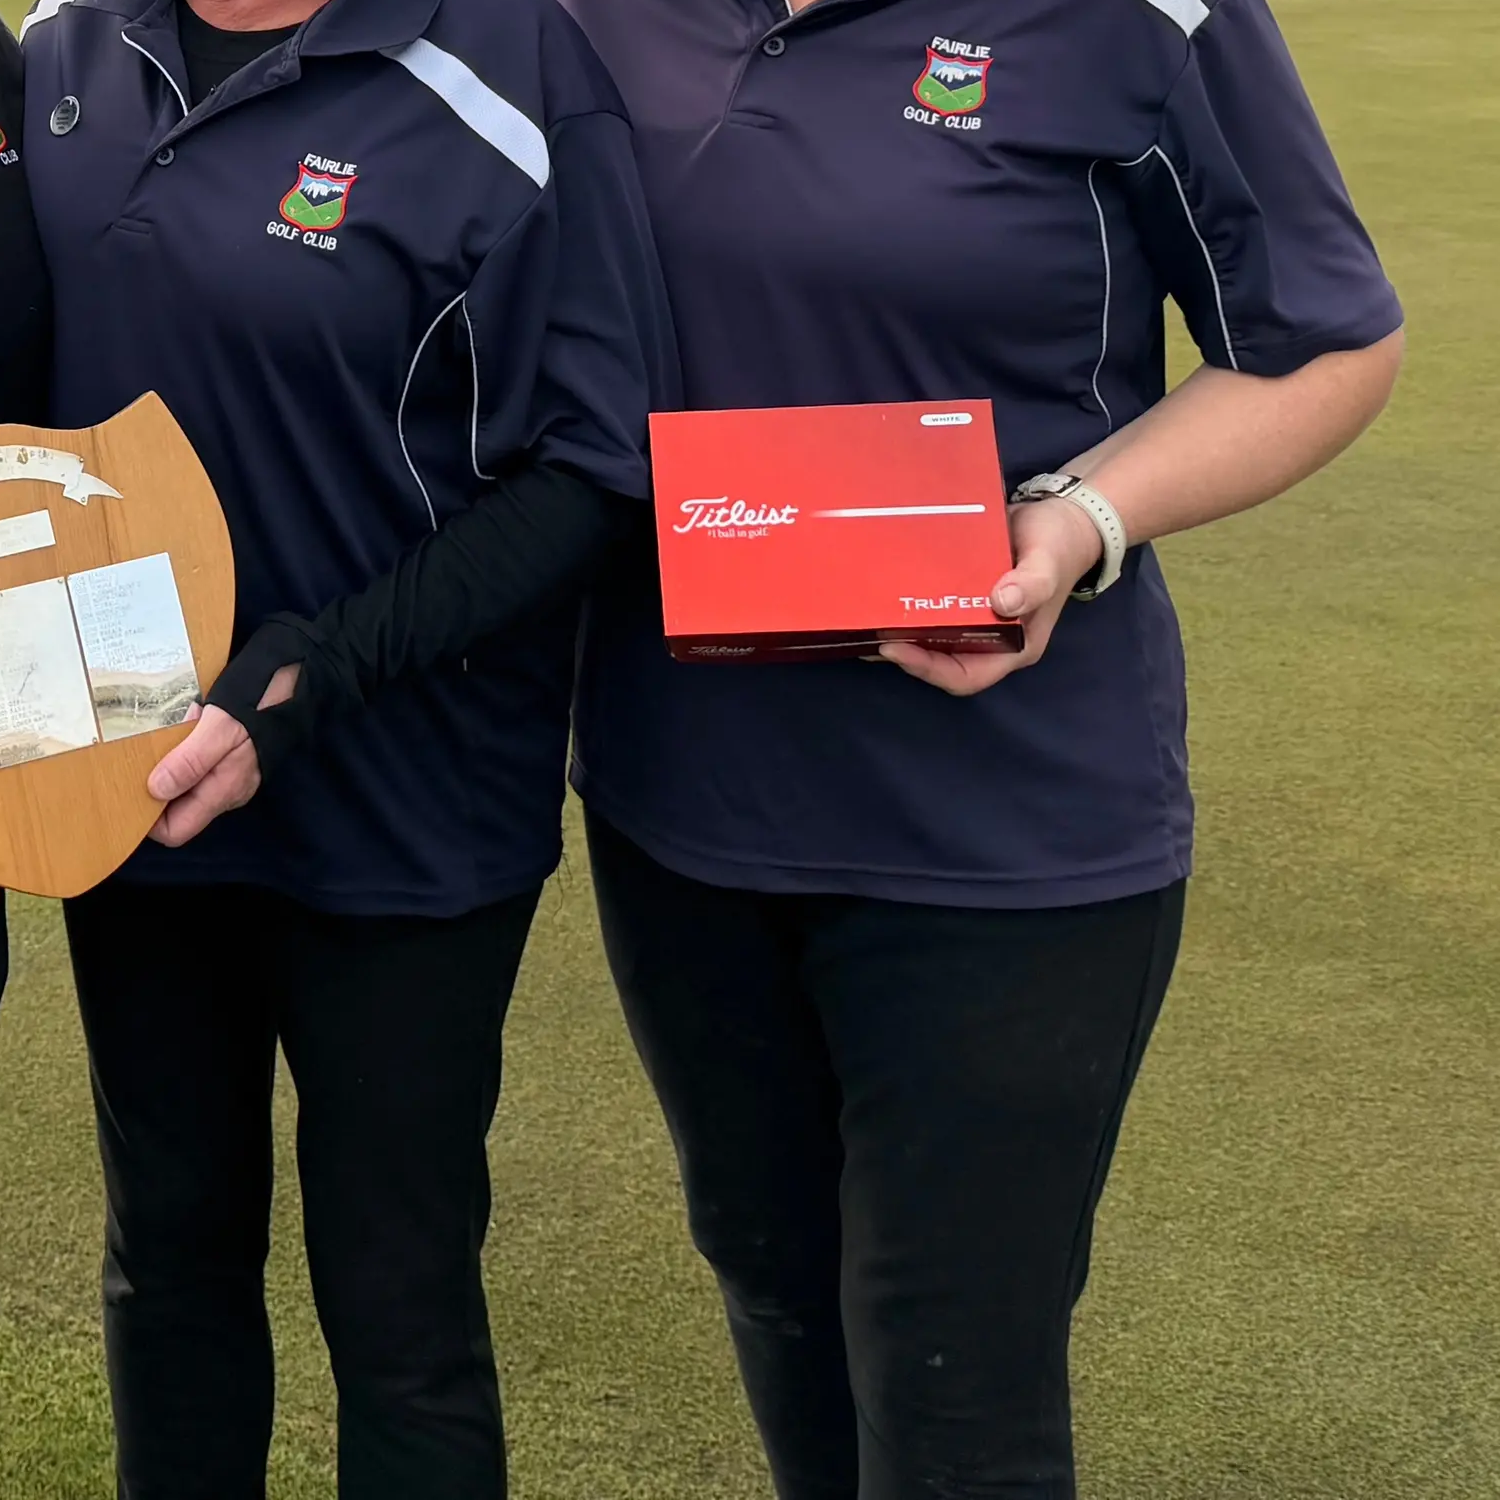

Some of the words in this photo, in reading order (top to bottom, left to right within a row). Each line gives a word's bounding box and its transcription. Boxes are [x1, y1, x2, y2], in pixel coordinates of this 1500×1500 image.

[931, 36, 991, 58] FAIRLIE
[903, 105, 940, 125] GOLF
[944, 115, 982, 130] CLUB
[303, 153, 357, 175] FAIRLIE
[266, 221, 300, 240] GOLF
[302, 232, 337, 250] CLUB
[673, 496, 799, 533] Titleist
[718, 528, 735, 538] ball
[737, 528, 747, 537] in
